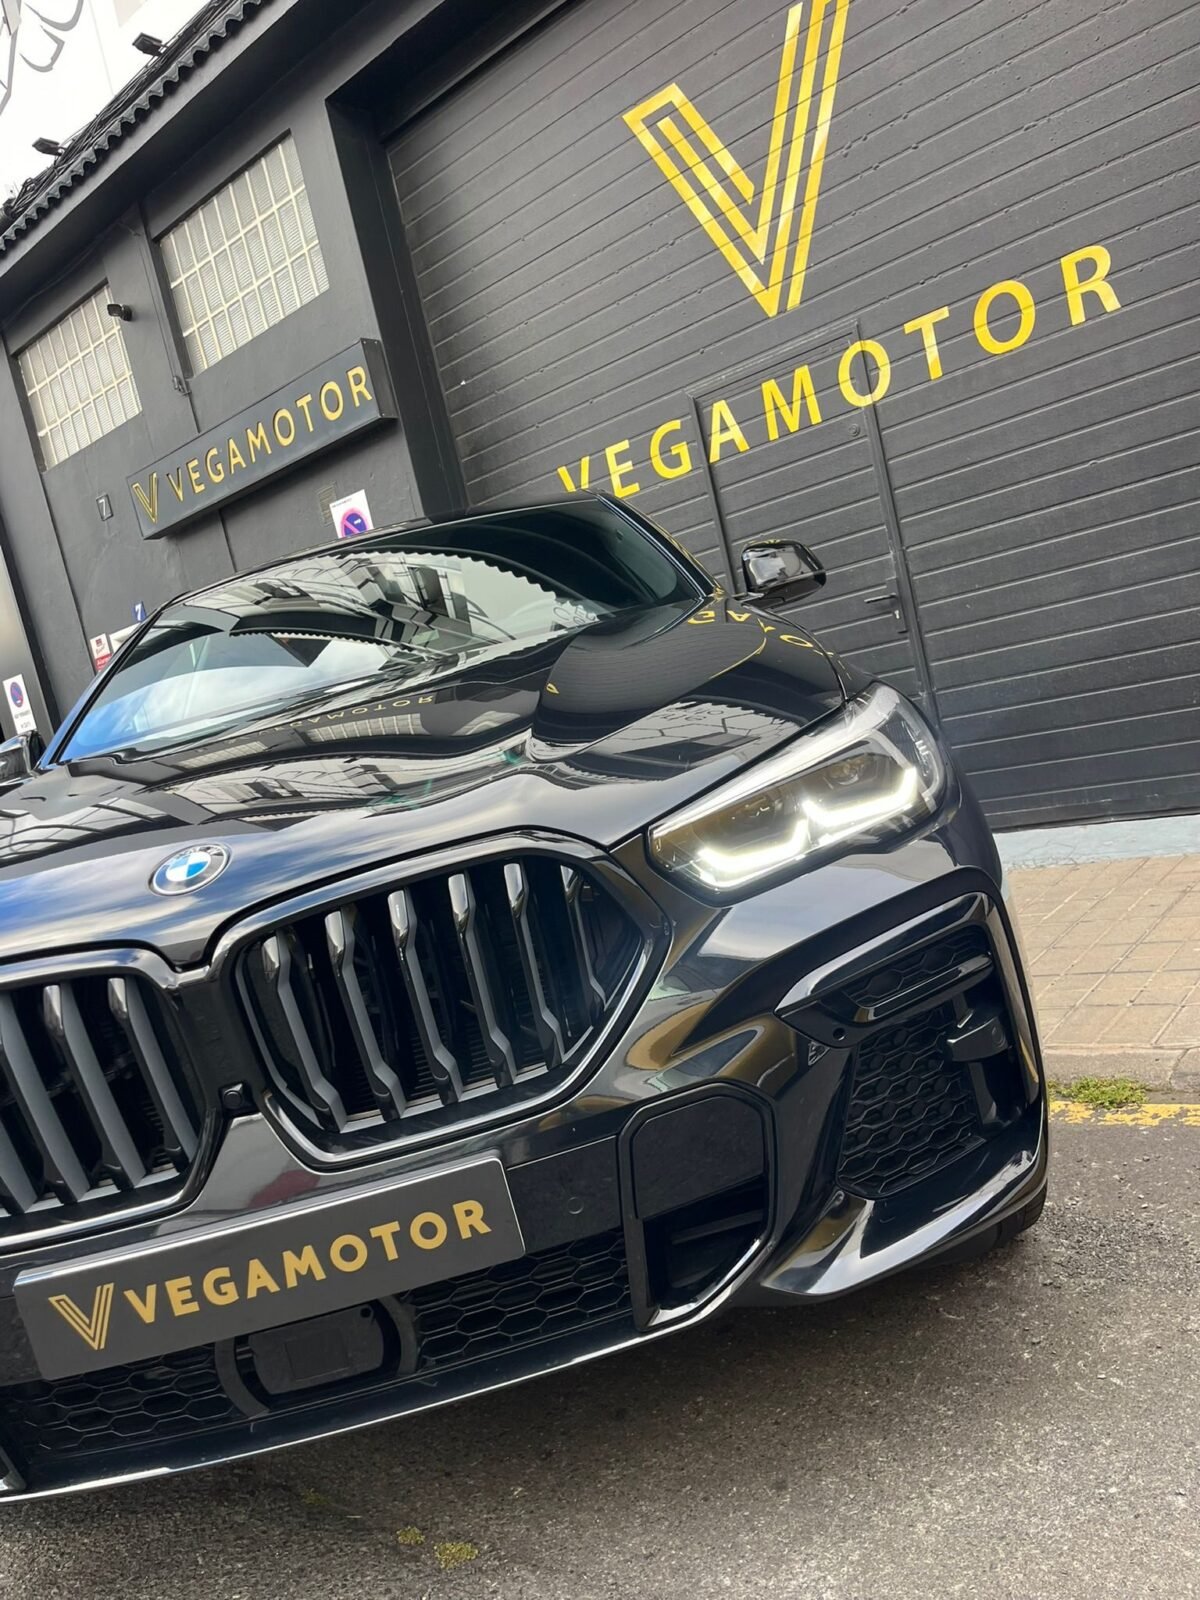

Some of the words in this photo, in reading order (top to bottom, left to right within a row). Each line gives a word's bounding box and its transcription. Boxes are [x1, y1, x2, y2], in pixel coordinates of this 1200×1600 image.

[166, 366, 373, 502] VEGAMOTOR
[557, 245, 1122, 498] VEGAMOTOR
[123, 1199, 492, 1324] VEGAMOTOR
